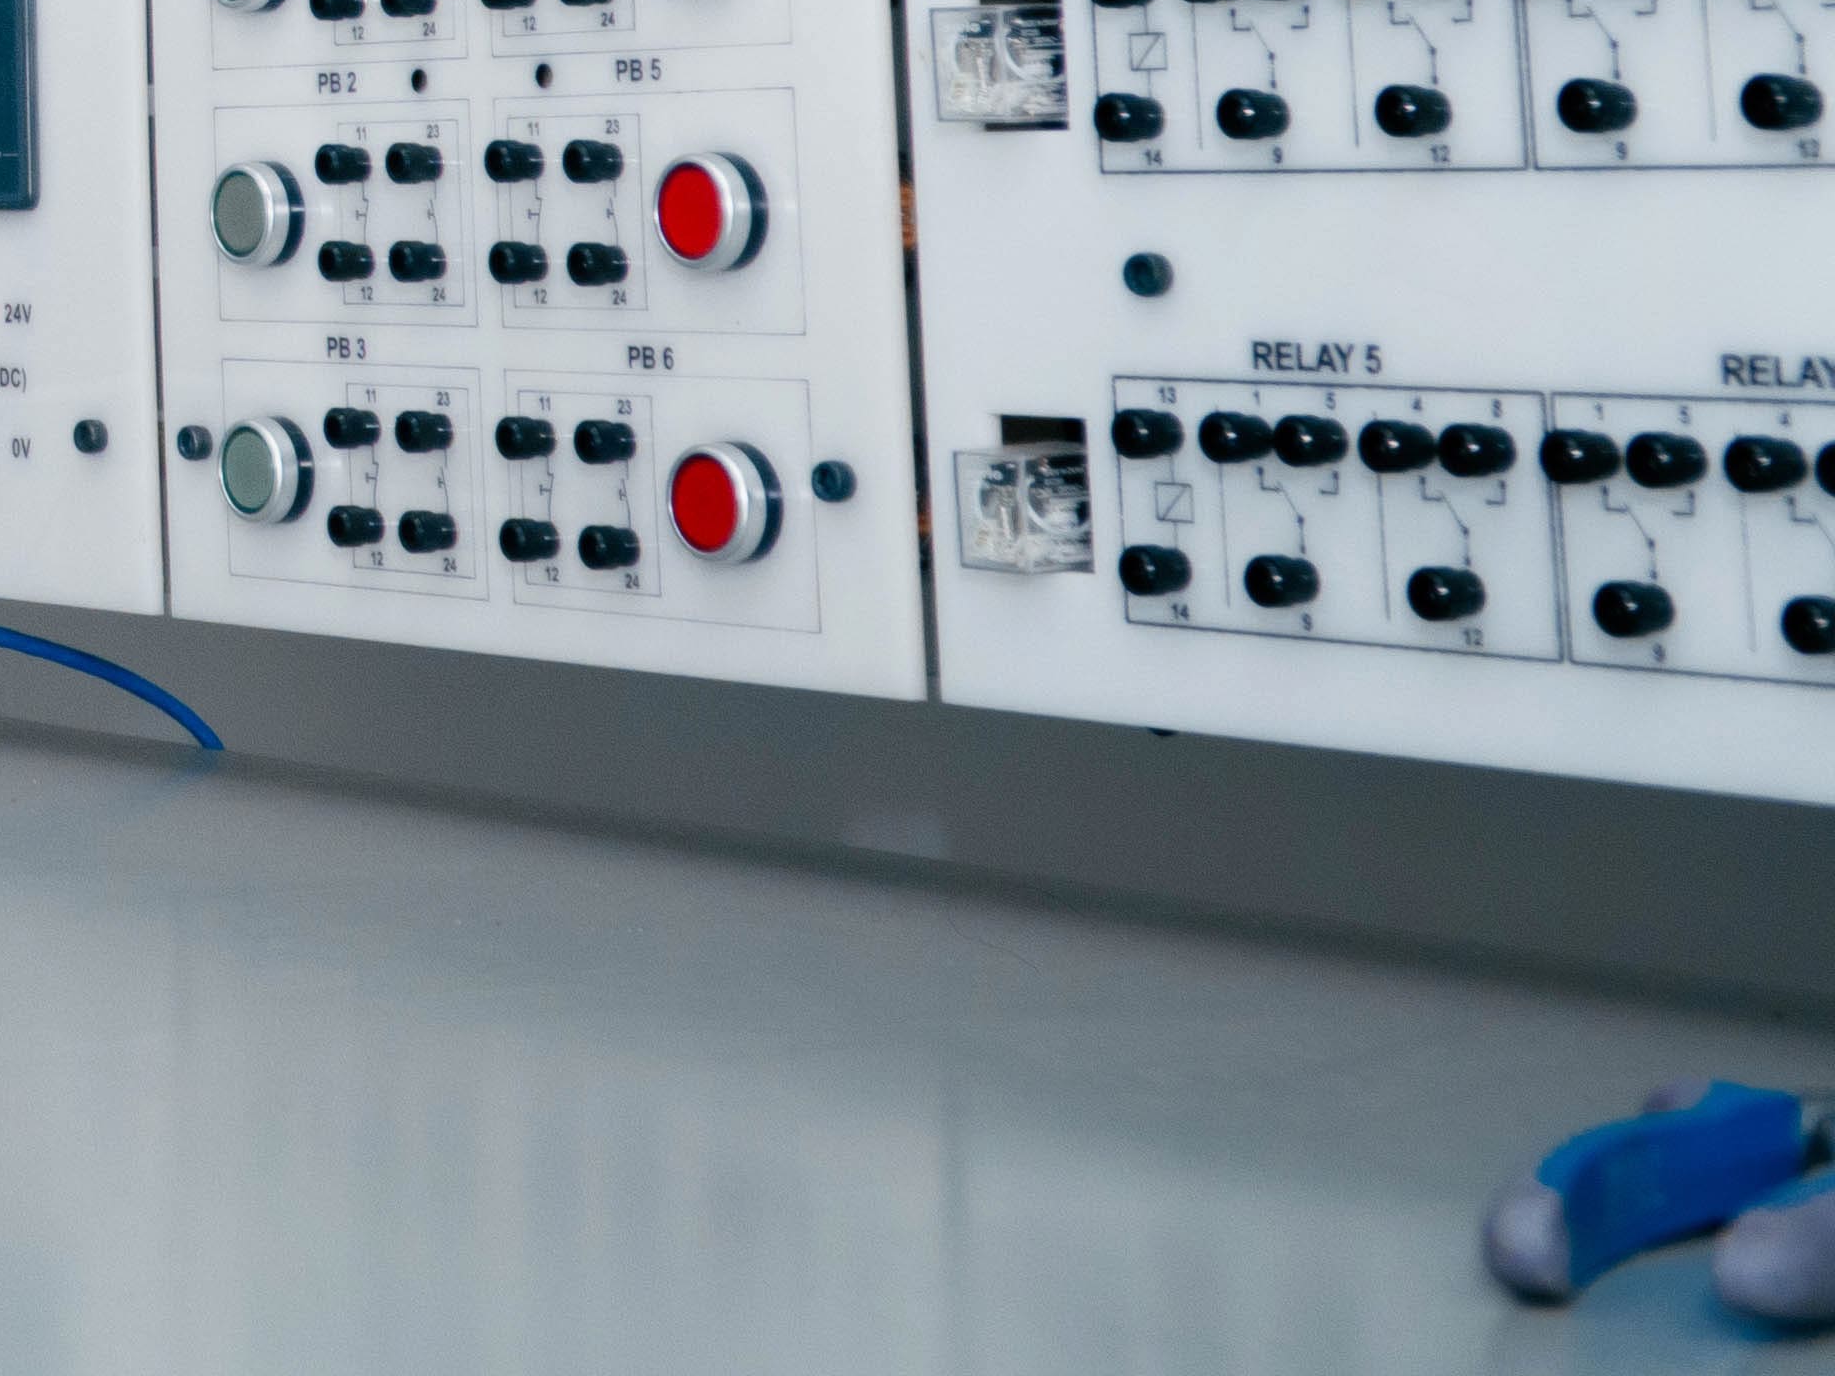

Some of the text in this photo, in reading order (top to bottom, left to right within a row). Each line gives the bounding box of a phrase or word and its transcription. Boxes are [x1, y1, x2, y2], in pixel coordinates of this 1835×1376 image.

[616, 59, 661, 81] PB 5
[319, 72, 357, 93] PB 2
[5, 305, 31, 323] 24V
[327, 337, 366, 359] PB 3
[628, 347, 674, 370] PB 6
[1253, 342, 1381, 373] RELAY 5
[12, 439, 30, 458] 0V
